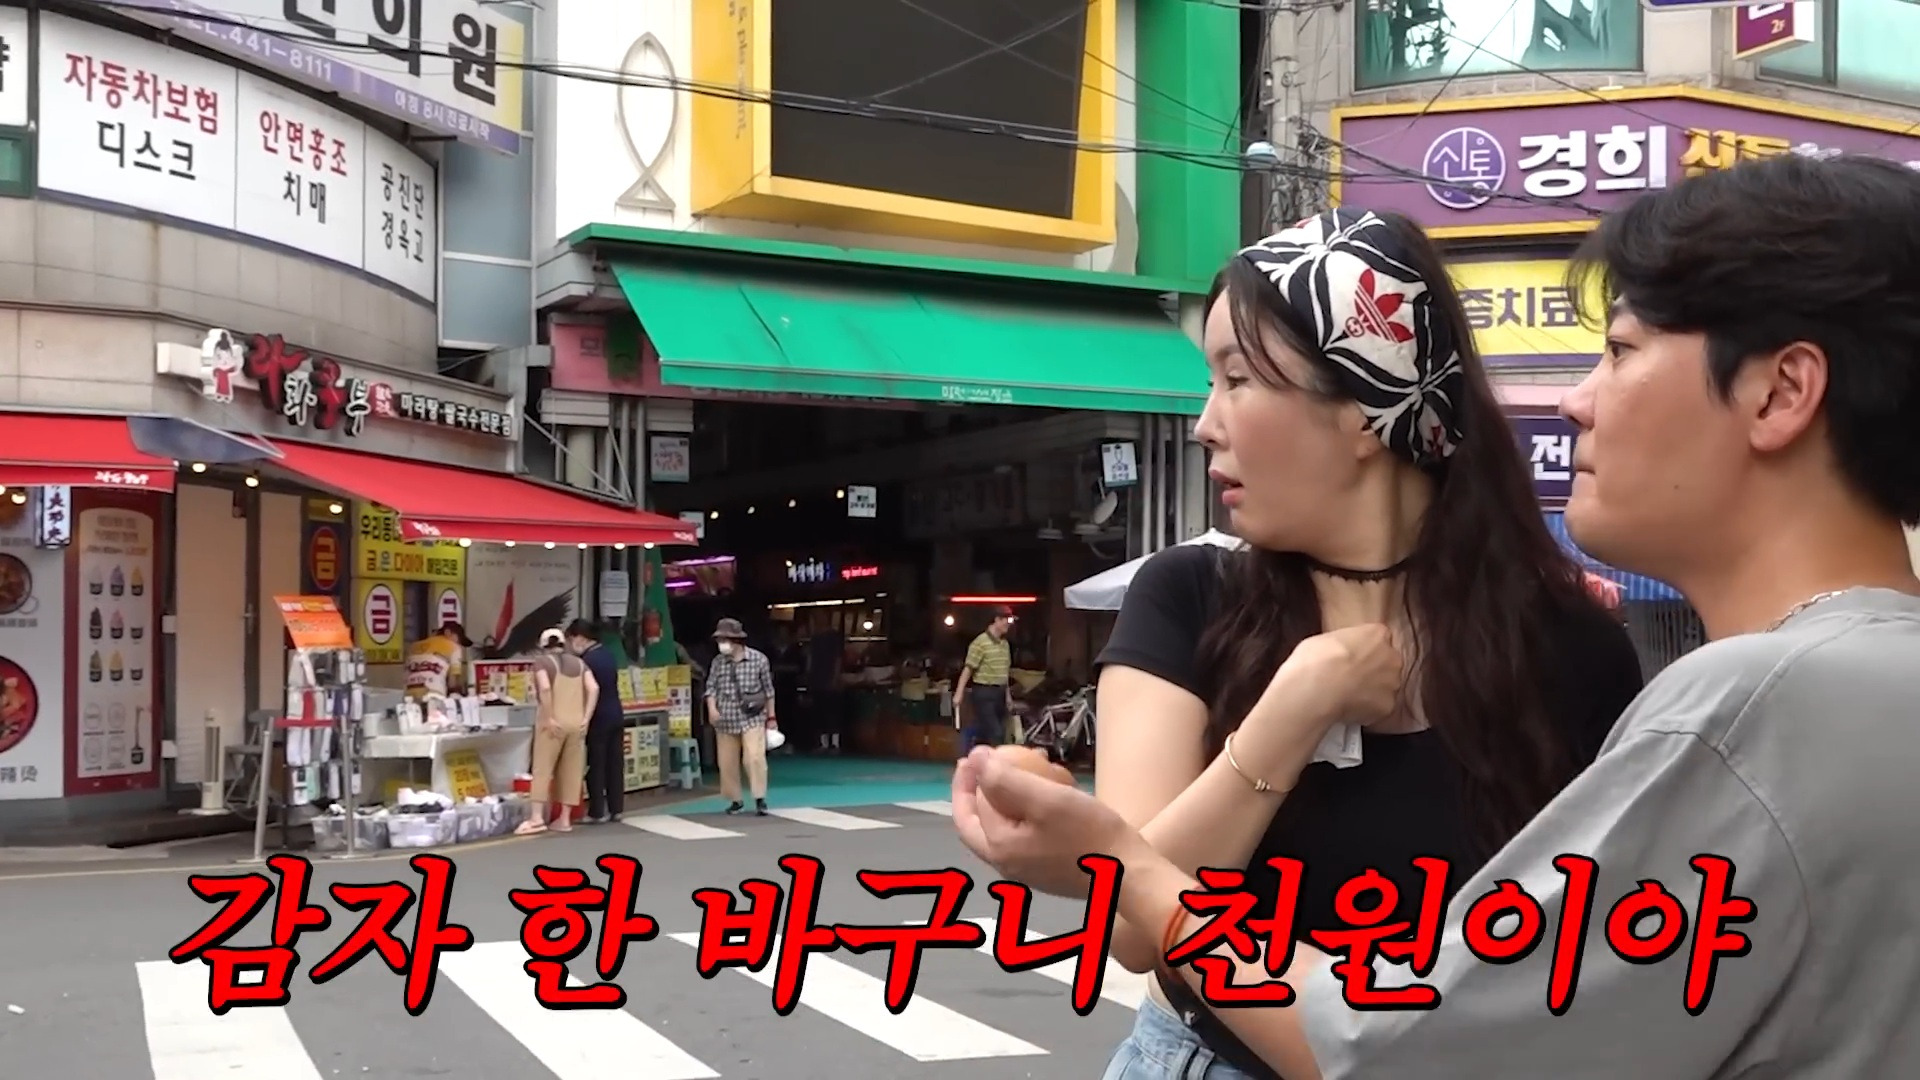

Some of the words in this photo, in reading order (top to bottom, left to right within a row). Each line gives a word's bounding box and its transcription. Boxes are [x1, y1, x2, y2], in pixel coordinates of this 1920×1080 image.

[1770, 19, 1786, 34] 2F
[64, 52, 220, 135] 자동차보험
[394, 90, 419, 114] 아침
[423, 101, 444, 123] 8시
[97, 120, 196, 181] 디스크
[260, 110, 348, 177] 안면홍조
[1518, 125, 1668, 198] 경희
[283, 171, 326, 224] 치매
[381, 162, 424, 220] 공진단
[381, 211, 424, 263] 경옥고
[1530, 434, 1571, 481] 전
[369, 594, 392, 635] 금
